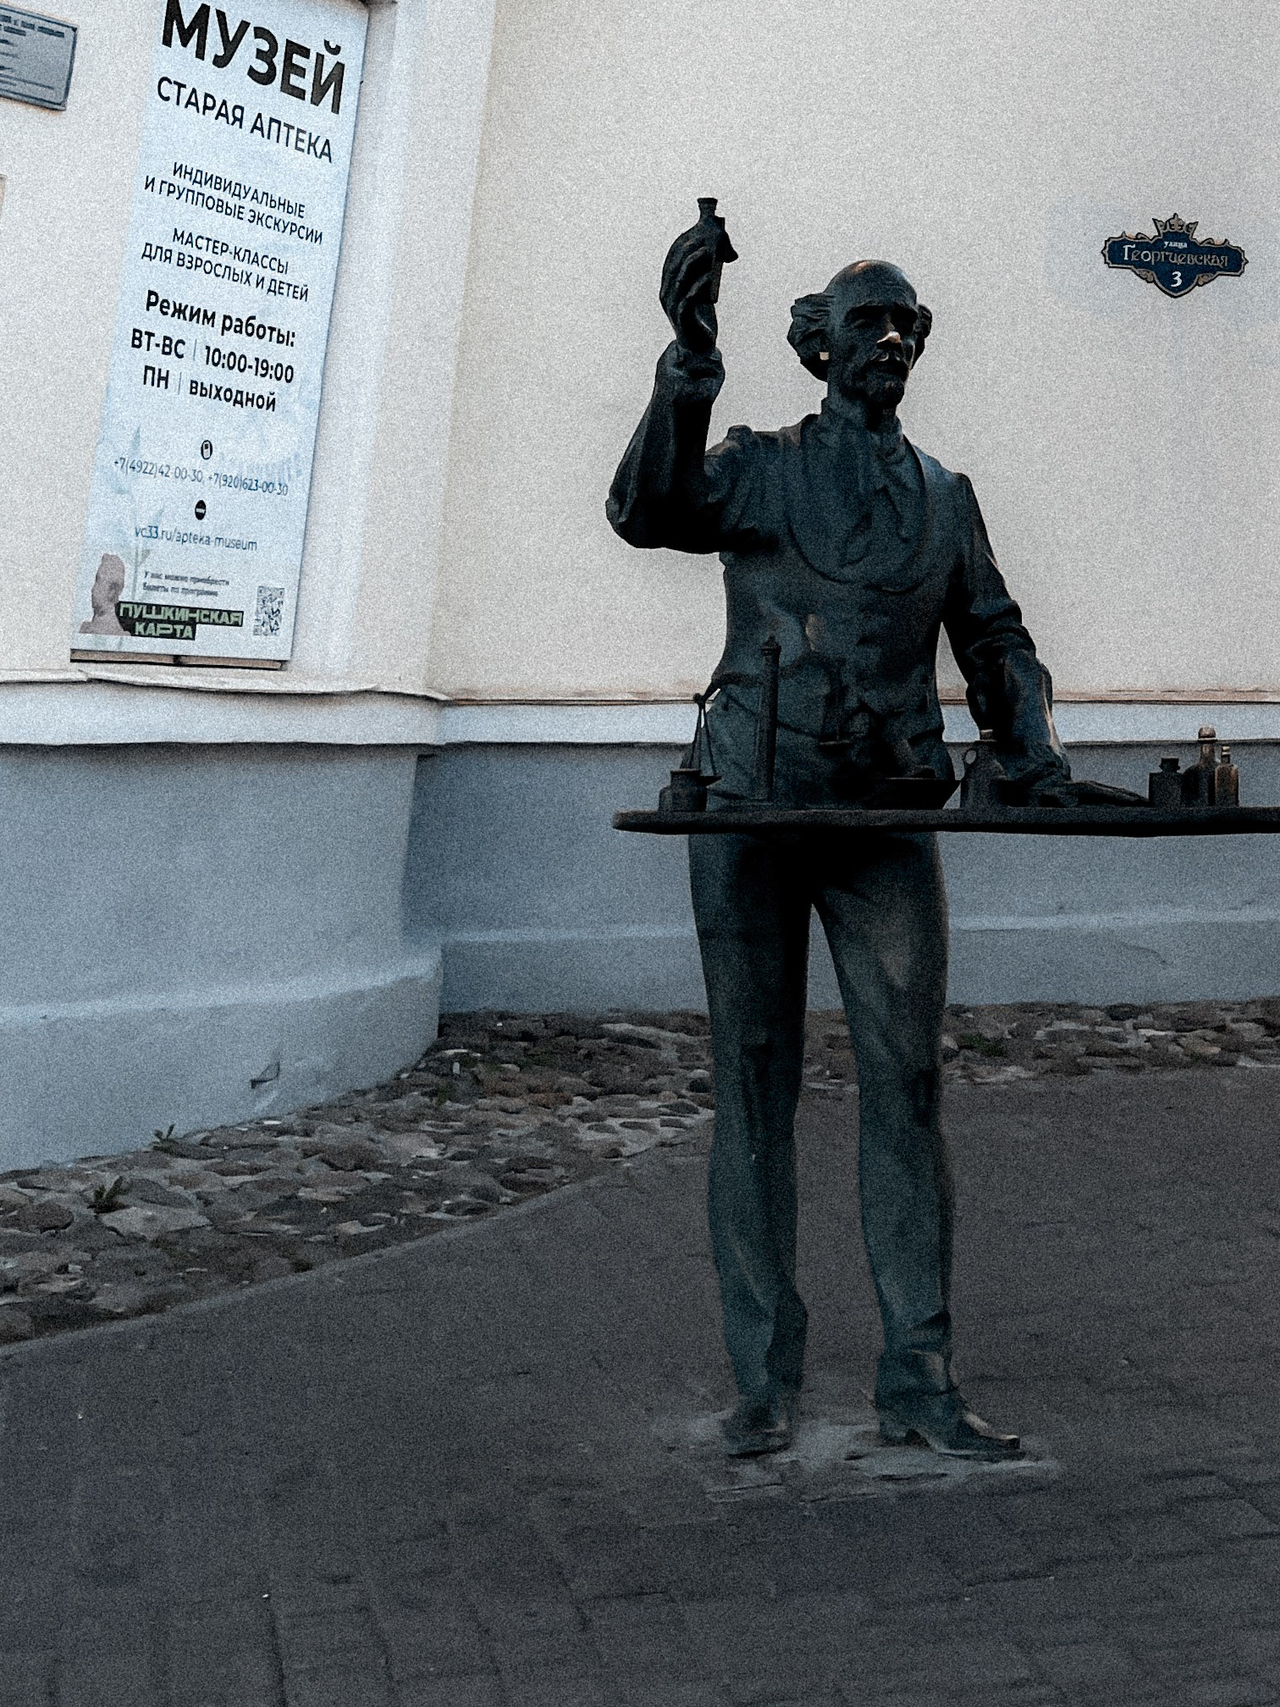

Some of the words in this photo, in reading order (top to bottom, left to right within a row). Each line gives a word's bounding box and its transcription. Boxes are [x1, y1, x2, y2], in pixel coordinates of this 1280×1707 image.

[157, 76, 245, 129] СТАРАЯ
[250, 112, 332, 163] АПТЕКА
[144, 175, 155, 192] И
[159, 180, 245, 220] ГРУППОВЫЕ
[248, 208, 323, 245] ЭКСКУРСИИ
[172, 161, 305, 219] ИНДИВИДУАЛЬНЫЕ
[141, 243, 172, 264] ДЛЯ
[176, 252, 252, 287] ВЗРОСЛЫХ
[255, 274, 264, 289] И
[267, 279, 309, 302] ДЕТЕЙ
[172, 228, 289, 275] МАСТЕР-КЛАССЫ
[1123, 244, 1228, 268] Георгиевская
[1170, 271, 1183, 287] 3
[146, 290, 216, 328] Режим
[221, 314, 296, 347] работы:
[131, 328, 186, 359] ВТ-ВС
[205, 345, 294, 383] 10:00-19:00
[143, 365, 170, 389] ПН
[189, 379, 276, 412] выходной
[119, 602, 242, 626] ПУШКИНСКАЯ
[135, 621, 193, 638] КАРТА
